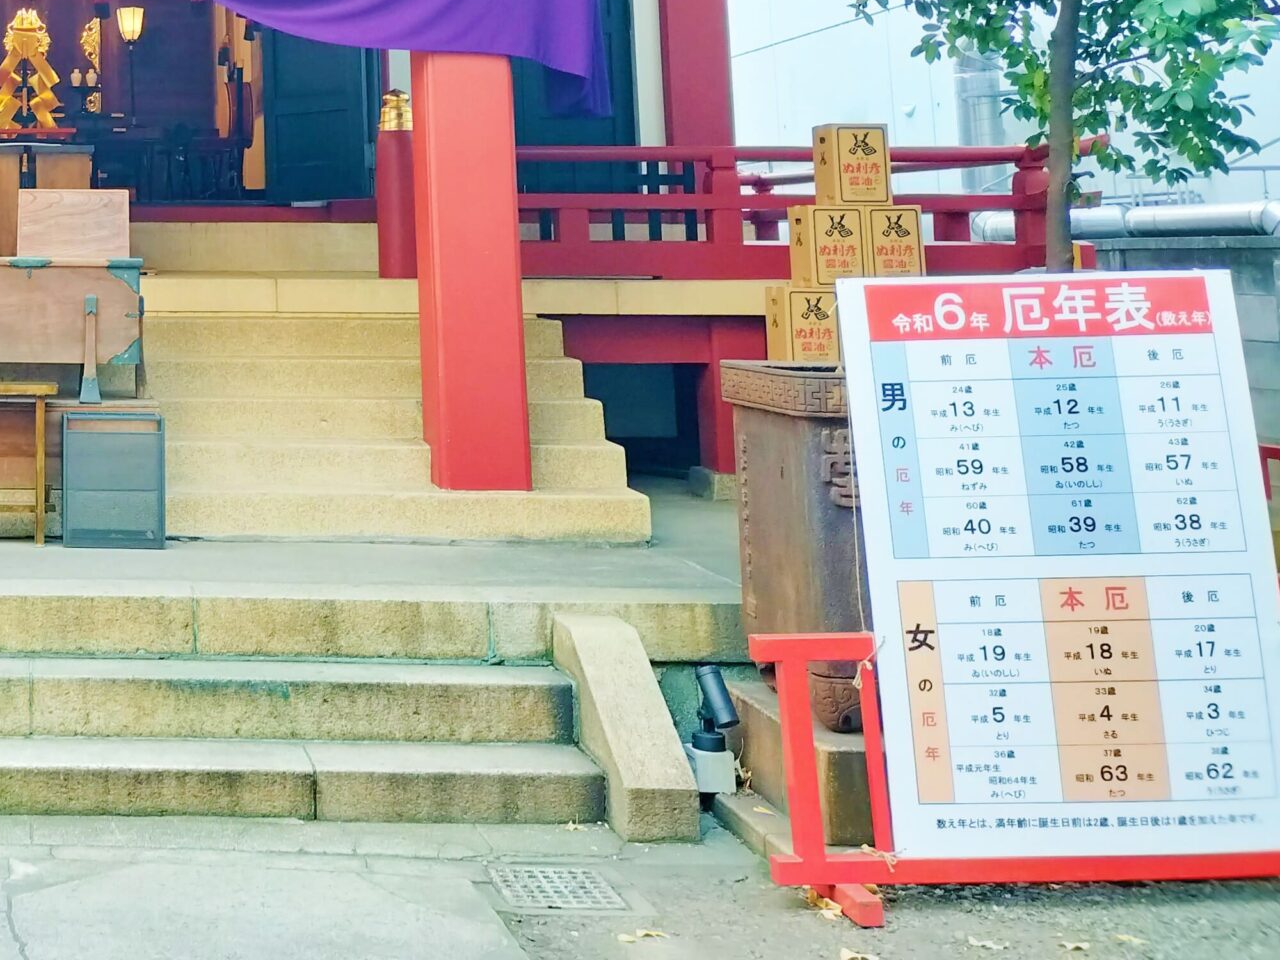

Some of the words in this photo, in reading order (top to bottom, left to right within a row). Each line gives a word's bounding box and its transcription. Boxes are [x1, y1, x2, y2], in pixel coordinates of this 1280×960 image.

[842, 162, 881, 174] ぬ利彦
[819, 245, 858, 257] ぬ利彦
[876, 245, 915, 257] ぬ利彦
[892, 292, 990, 334] 令和6年
[1003, 284, 1154, 333] 厄年表
[795, 327, 834, 340] ぬ利彦
[940, 353, 977, 366] 前厄
[1028, 345, 1097, 369] 本厄
[1147, 349, 1184, 361] 後厄
[952, 385, 972, 394] 24歳
[1056, 383, 1076, 392] 25歳
[1160, 381, 1180, 389] 26歳
[1063, 421, 1079, 430] たつ
[959, 442, 979, 451] 41歳
[1064, 440, 1084, 449] 42歳
[1168, 438, 1189, 446] 43歳
[961, 481, 987, 491] ねずみ
[1175, 477, 1193, 486] いぬ
[966, 501, 986, 510] 60歳
[1071, 499, 1092, 508] 61歳
[1176, 497, 1197, 505] 62歳
[1078, 540, 1095, 549] たつ
[969, 595, 1006, 607] 前厄
[1059, 587, 1129, 612] 本厄
[1182, 591, 1220, 603] 後厄
[982, 628, 1002, 637] 18歳
[1088, 626, 1109, 635] 19歳
[1194, 624, 1215, 633] 20歳
[1094, 667, 1112, 675] いぬ
[1203, 665, 1217, 674] とり
[989, 689, 1007, 697] 32歳
[1095, 687, 1116, 696] 33歳
[1203, 685, 1222, 694] 34歳
[996, 731, 1009, 740] とり
[1103, 730, 1118, 739] さる
[994, 750, 1015, 758] 36歳
[1103, 748, 1121, 757] 37歳
[956, 763, 1001, 773] 平成元年生
[989, 775, 1037, 785] 昭和64年生
[1109, 788, 1125, 797] たつ
